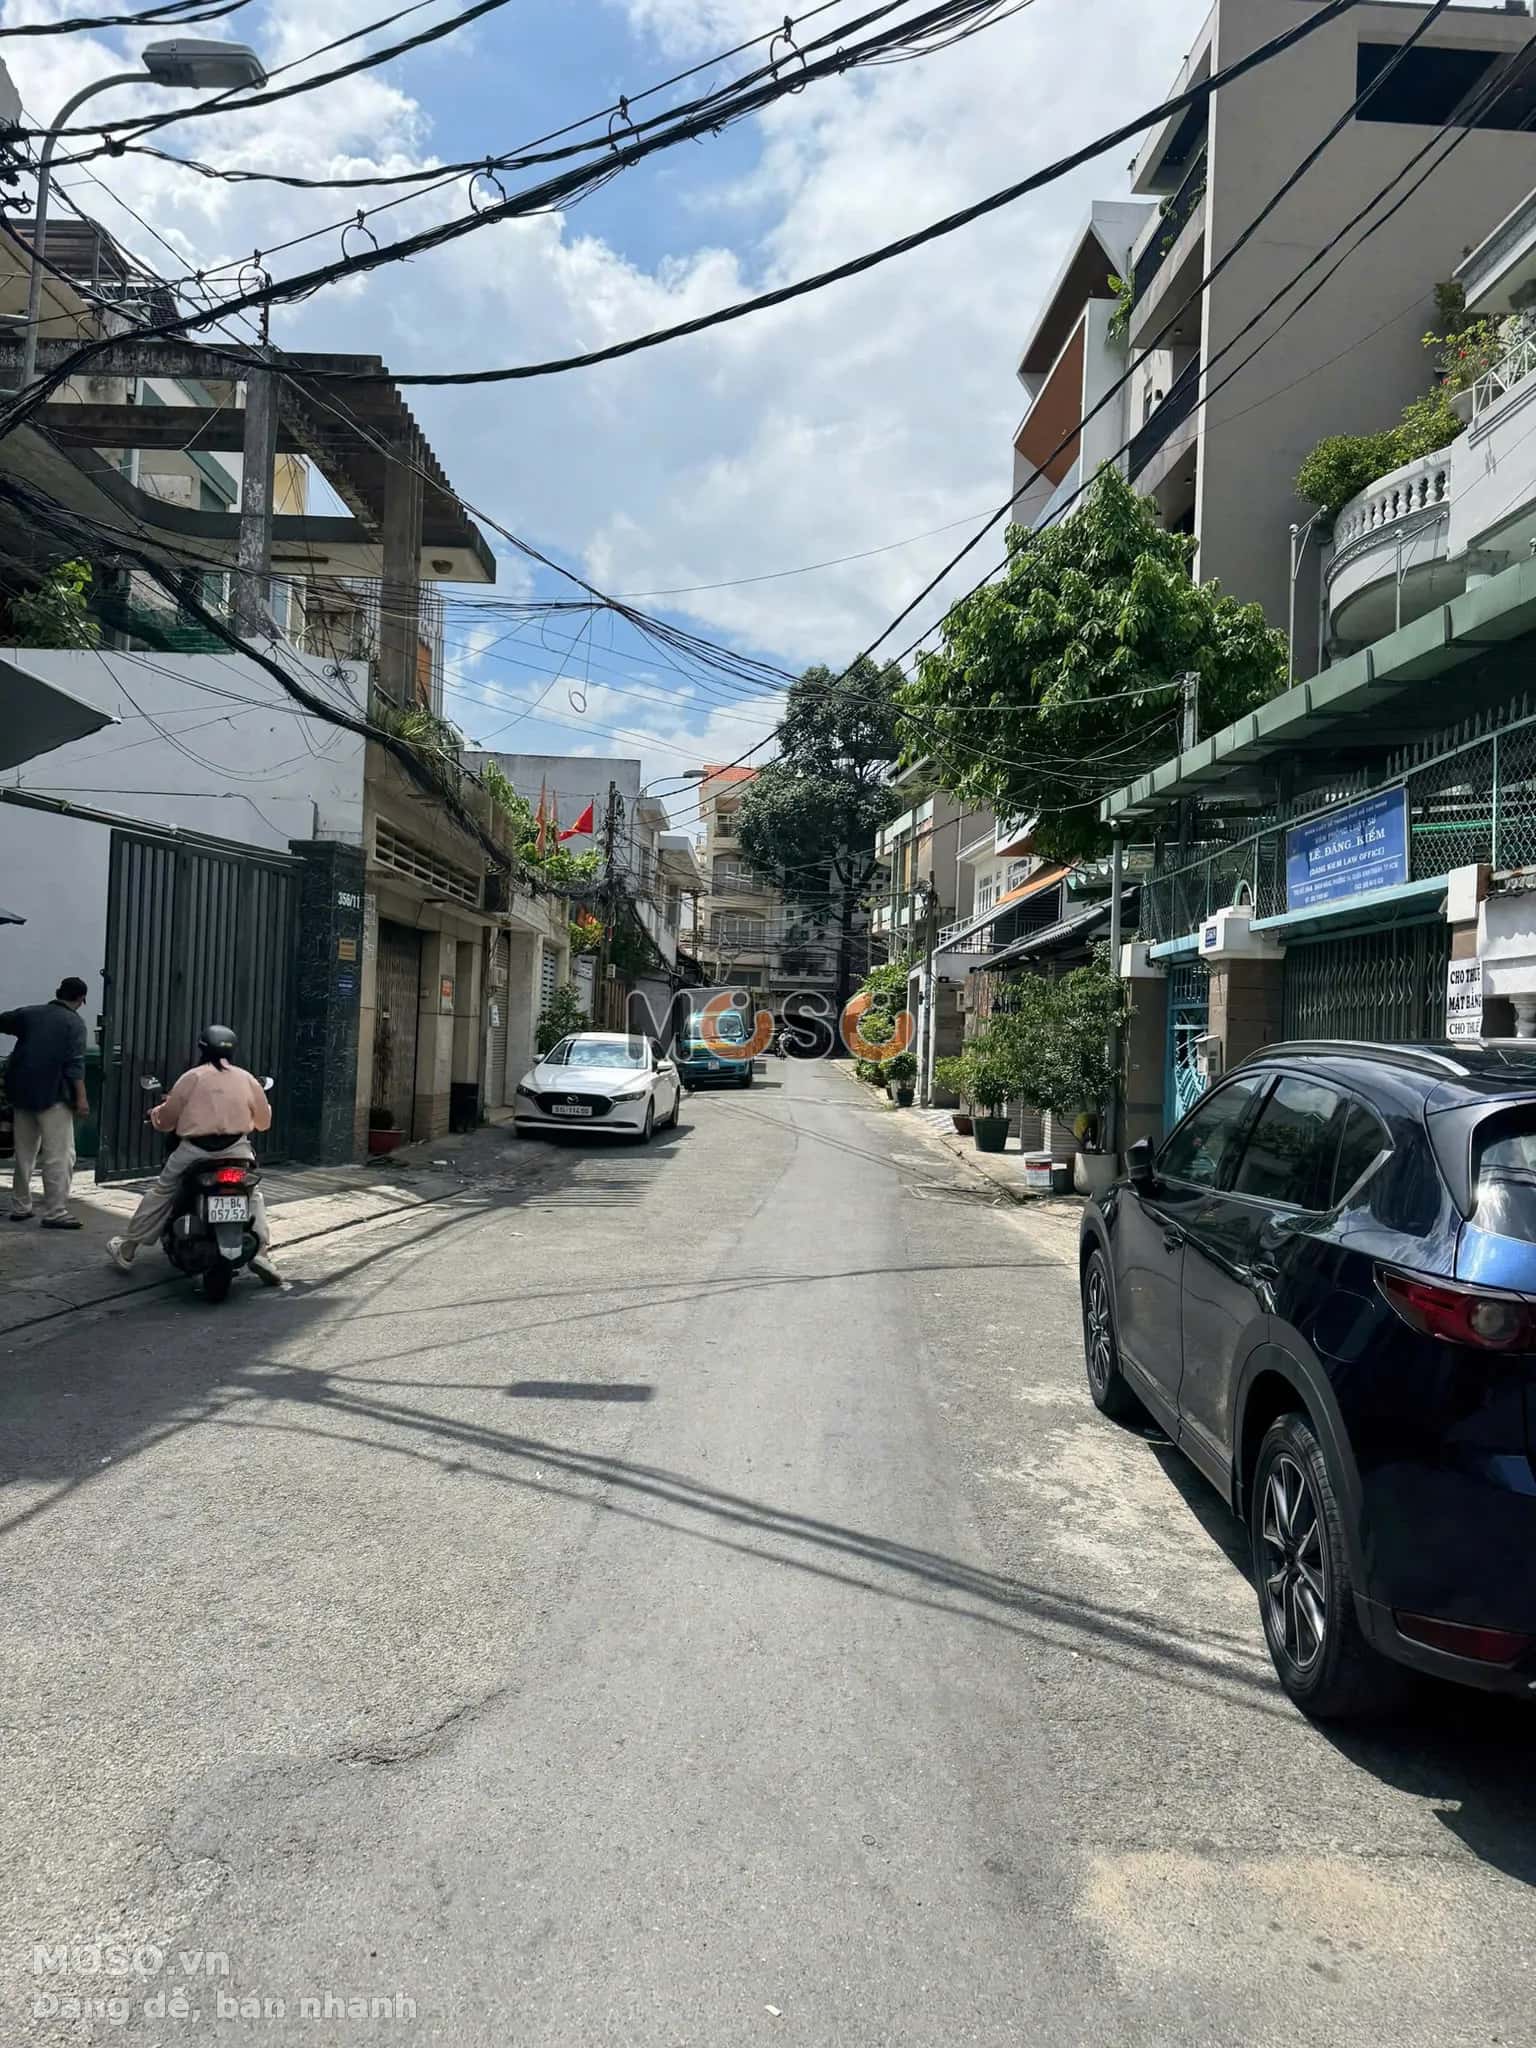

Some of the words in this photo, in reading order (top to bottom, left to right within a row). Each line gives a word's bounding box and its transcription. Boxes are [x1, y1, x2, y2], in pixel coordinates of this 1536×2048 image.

[1309, 847, 1321, 862] LÊ
[1343, 853, 1358, 866] LAW
[1449, 968, 1465, 985] CHO
[1449, 1022, 1465, 1035] CHO
